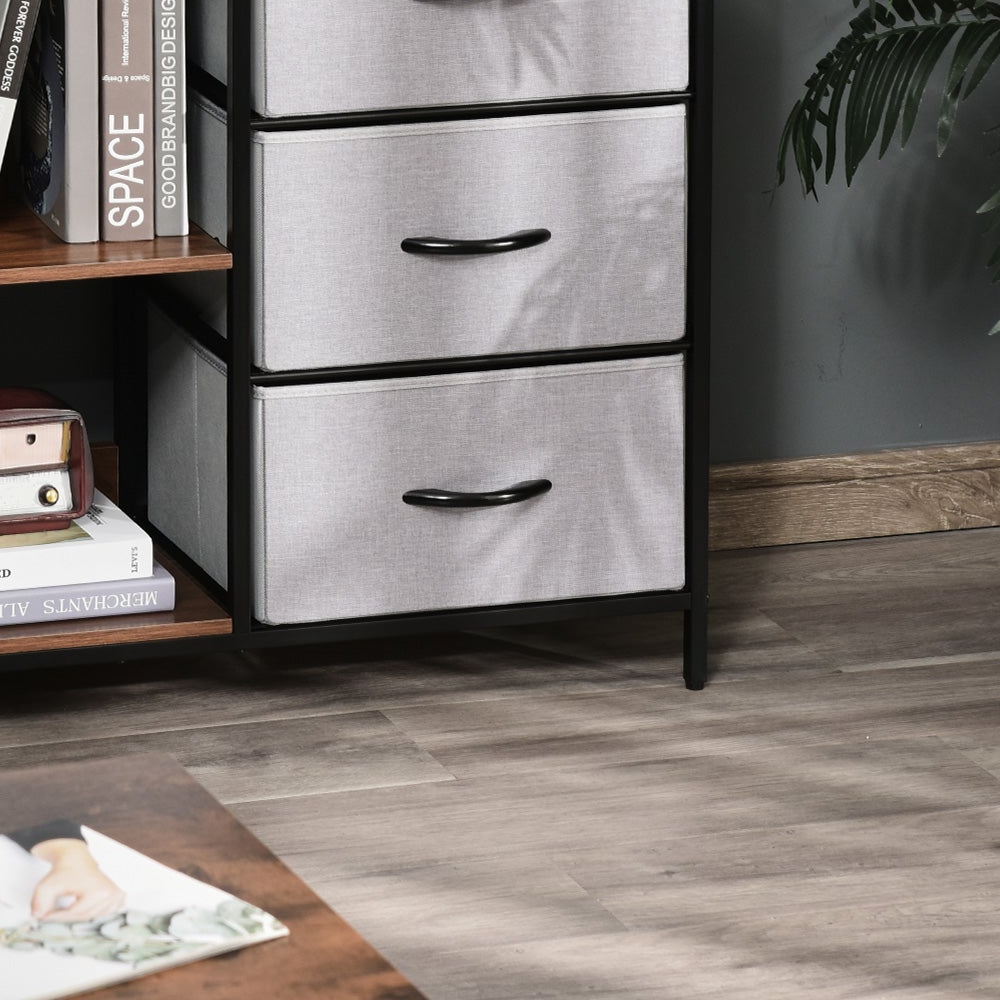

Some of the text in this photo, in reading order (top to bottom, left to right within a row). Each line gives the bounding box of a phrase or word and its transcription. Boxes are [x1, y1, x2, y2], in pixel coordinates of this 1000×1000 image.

[0, 0, 30, 92] FOREVER GODDESS
[121, 18, 131, 66] International
[108, 113, 145, 228] SPACE
[160, 154, 177, 209] GOOD
[43, 590, 158, 615] MERCHANTS
